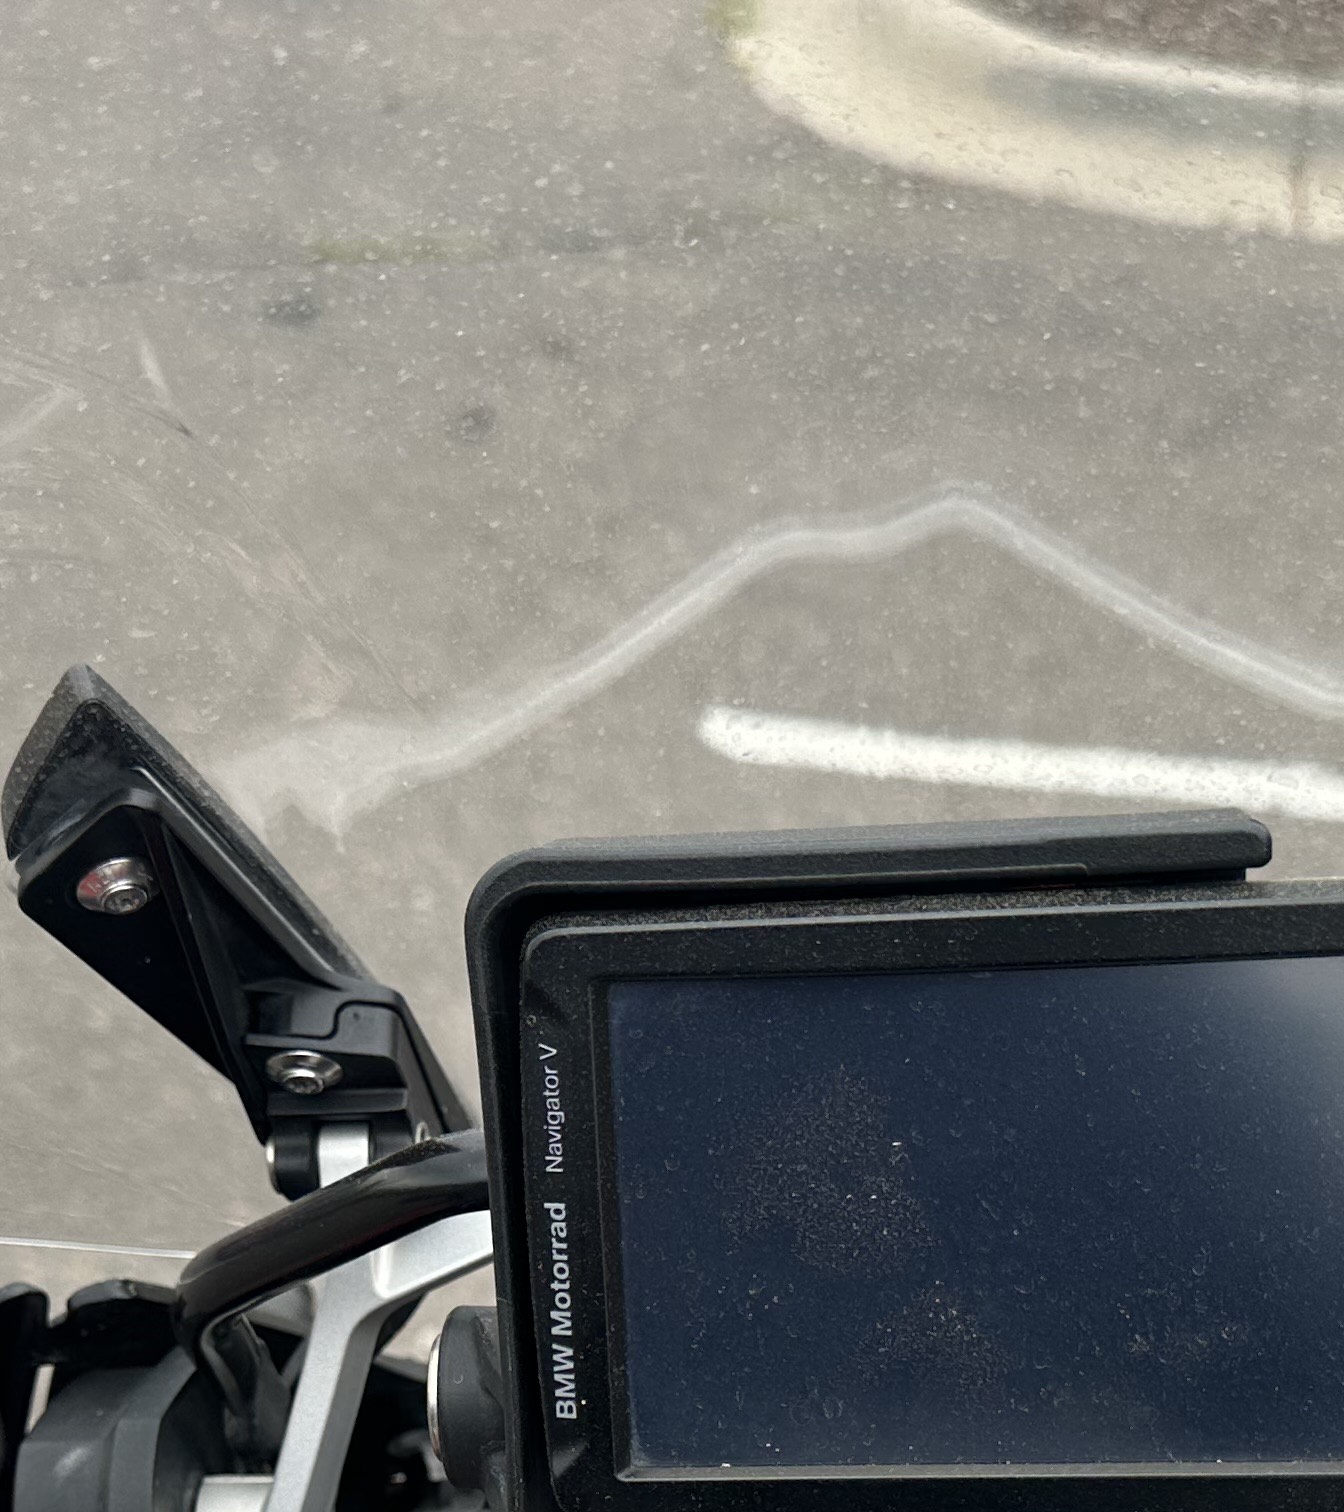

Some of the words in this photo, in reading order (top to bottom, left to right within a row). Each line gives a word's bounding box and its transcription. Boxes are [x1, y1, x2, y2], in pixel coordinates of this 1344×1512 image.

[538, 1043, 557, 1060] V
[543, 1065, 565, 1173] Navigator
[544, 1203, 572, 1336] Motorrad
[551, 1344, 577, 1419] BMW
